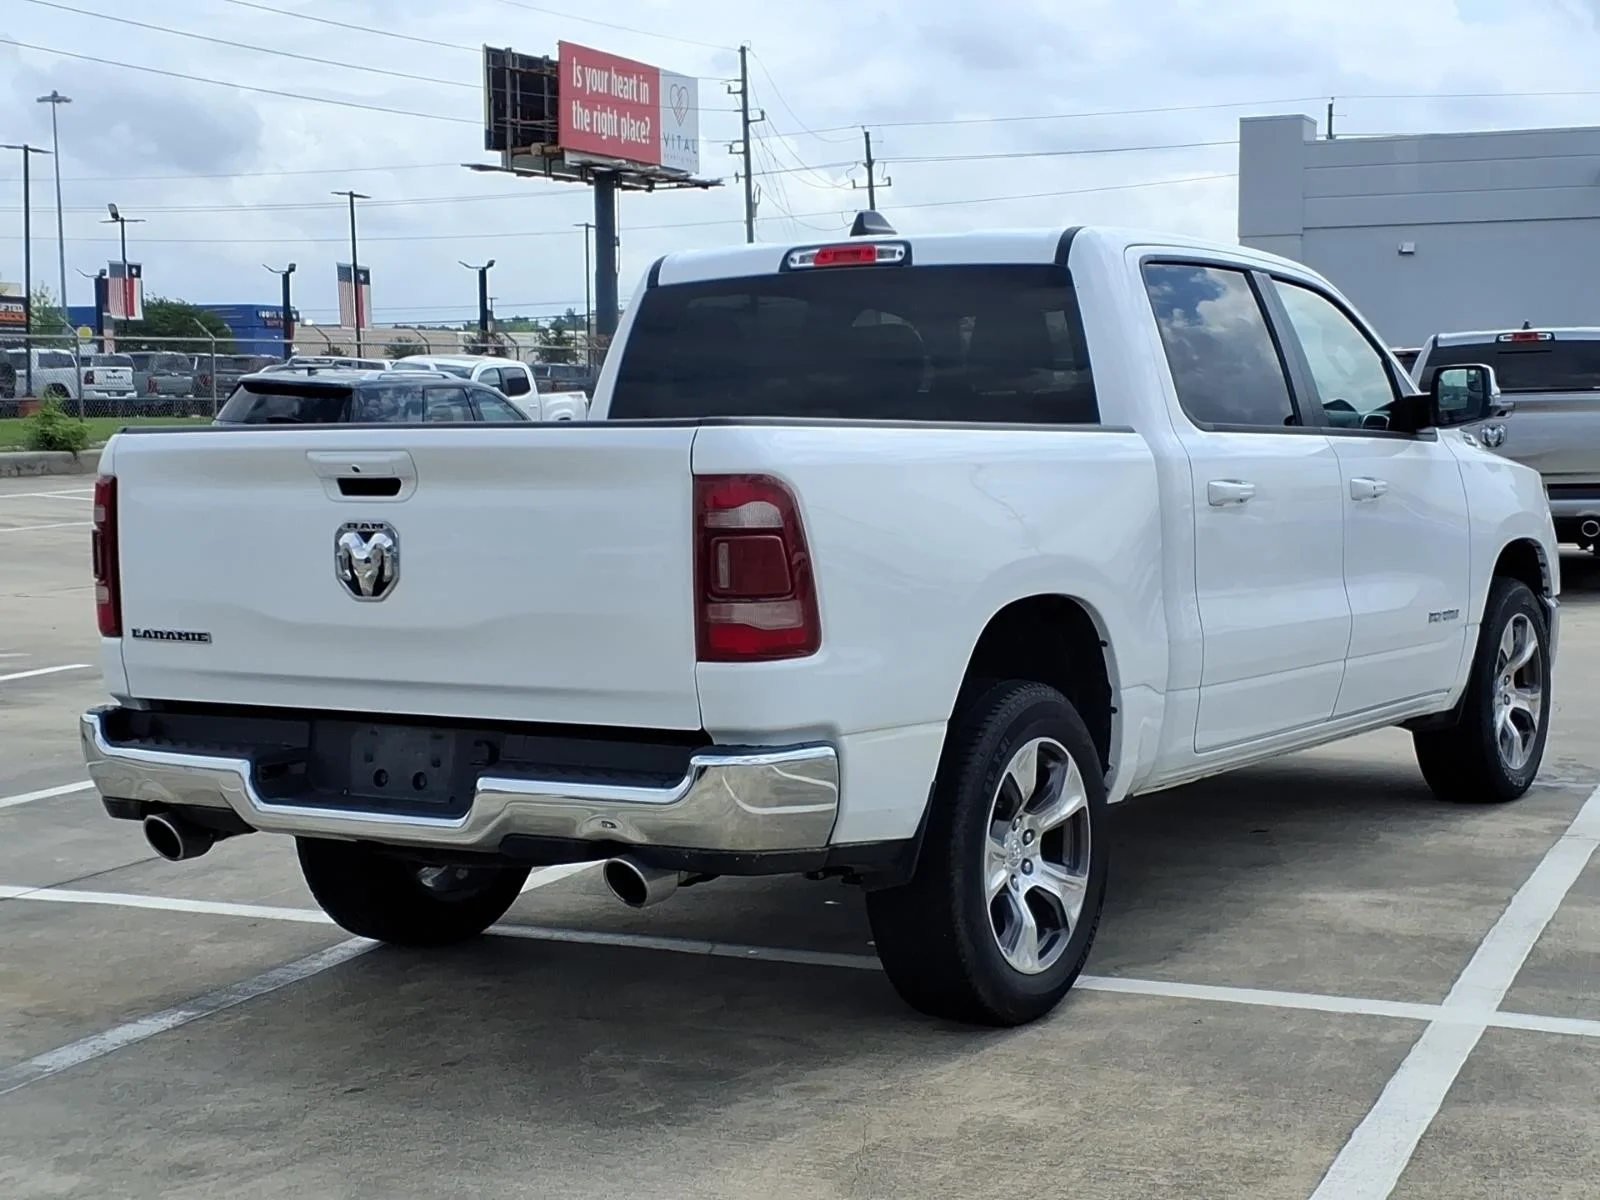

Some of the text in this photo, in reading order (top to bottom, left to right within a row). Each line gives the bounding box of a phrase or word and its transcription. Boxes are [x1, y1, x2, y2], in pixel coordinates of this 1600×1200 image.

[573, 56, 650, 104] Is your heart in
[572, 100, 651, 145] the right place?
[663, 132, 697, 154] VITAL
[346, 522, 384, 530] RAM
[131, 628, 209, 643] LARAMIE
